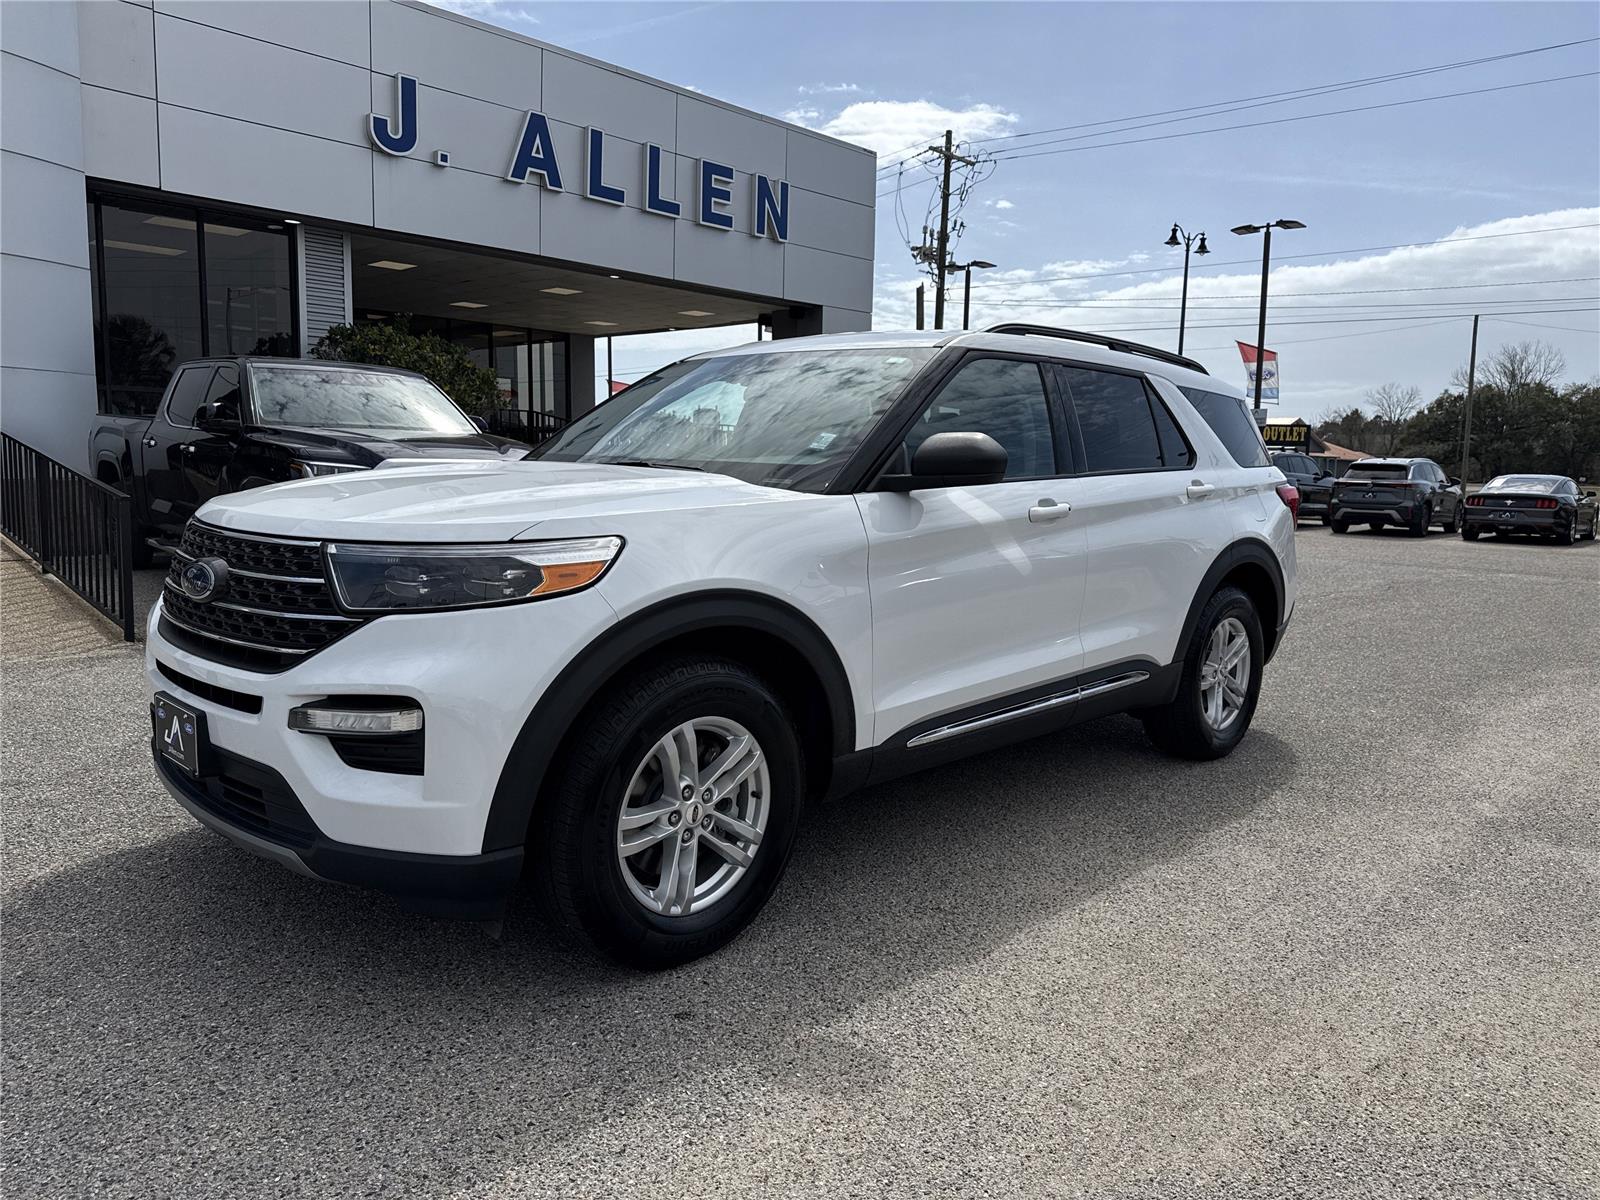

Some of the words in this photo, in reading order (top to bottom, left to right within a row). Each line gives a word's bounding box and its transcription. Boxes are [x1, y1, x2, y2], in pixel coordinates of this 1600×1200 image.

[366, 72, 450, 167] J.
[504, 109, 790, 243] ALLEN
[1263, 427, 1306, 441] OUTLET
